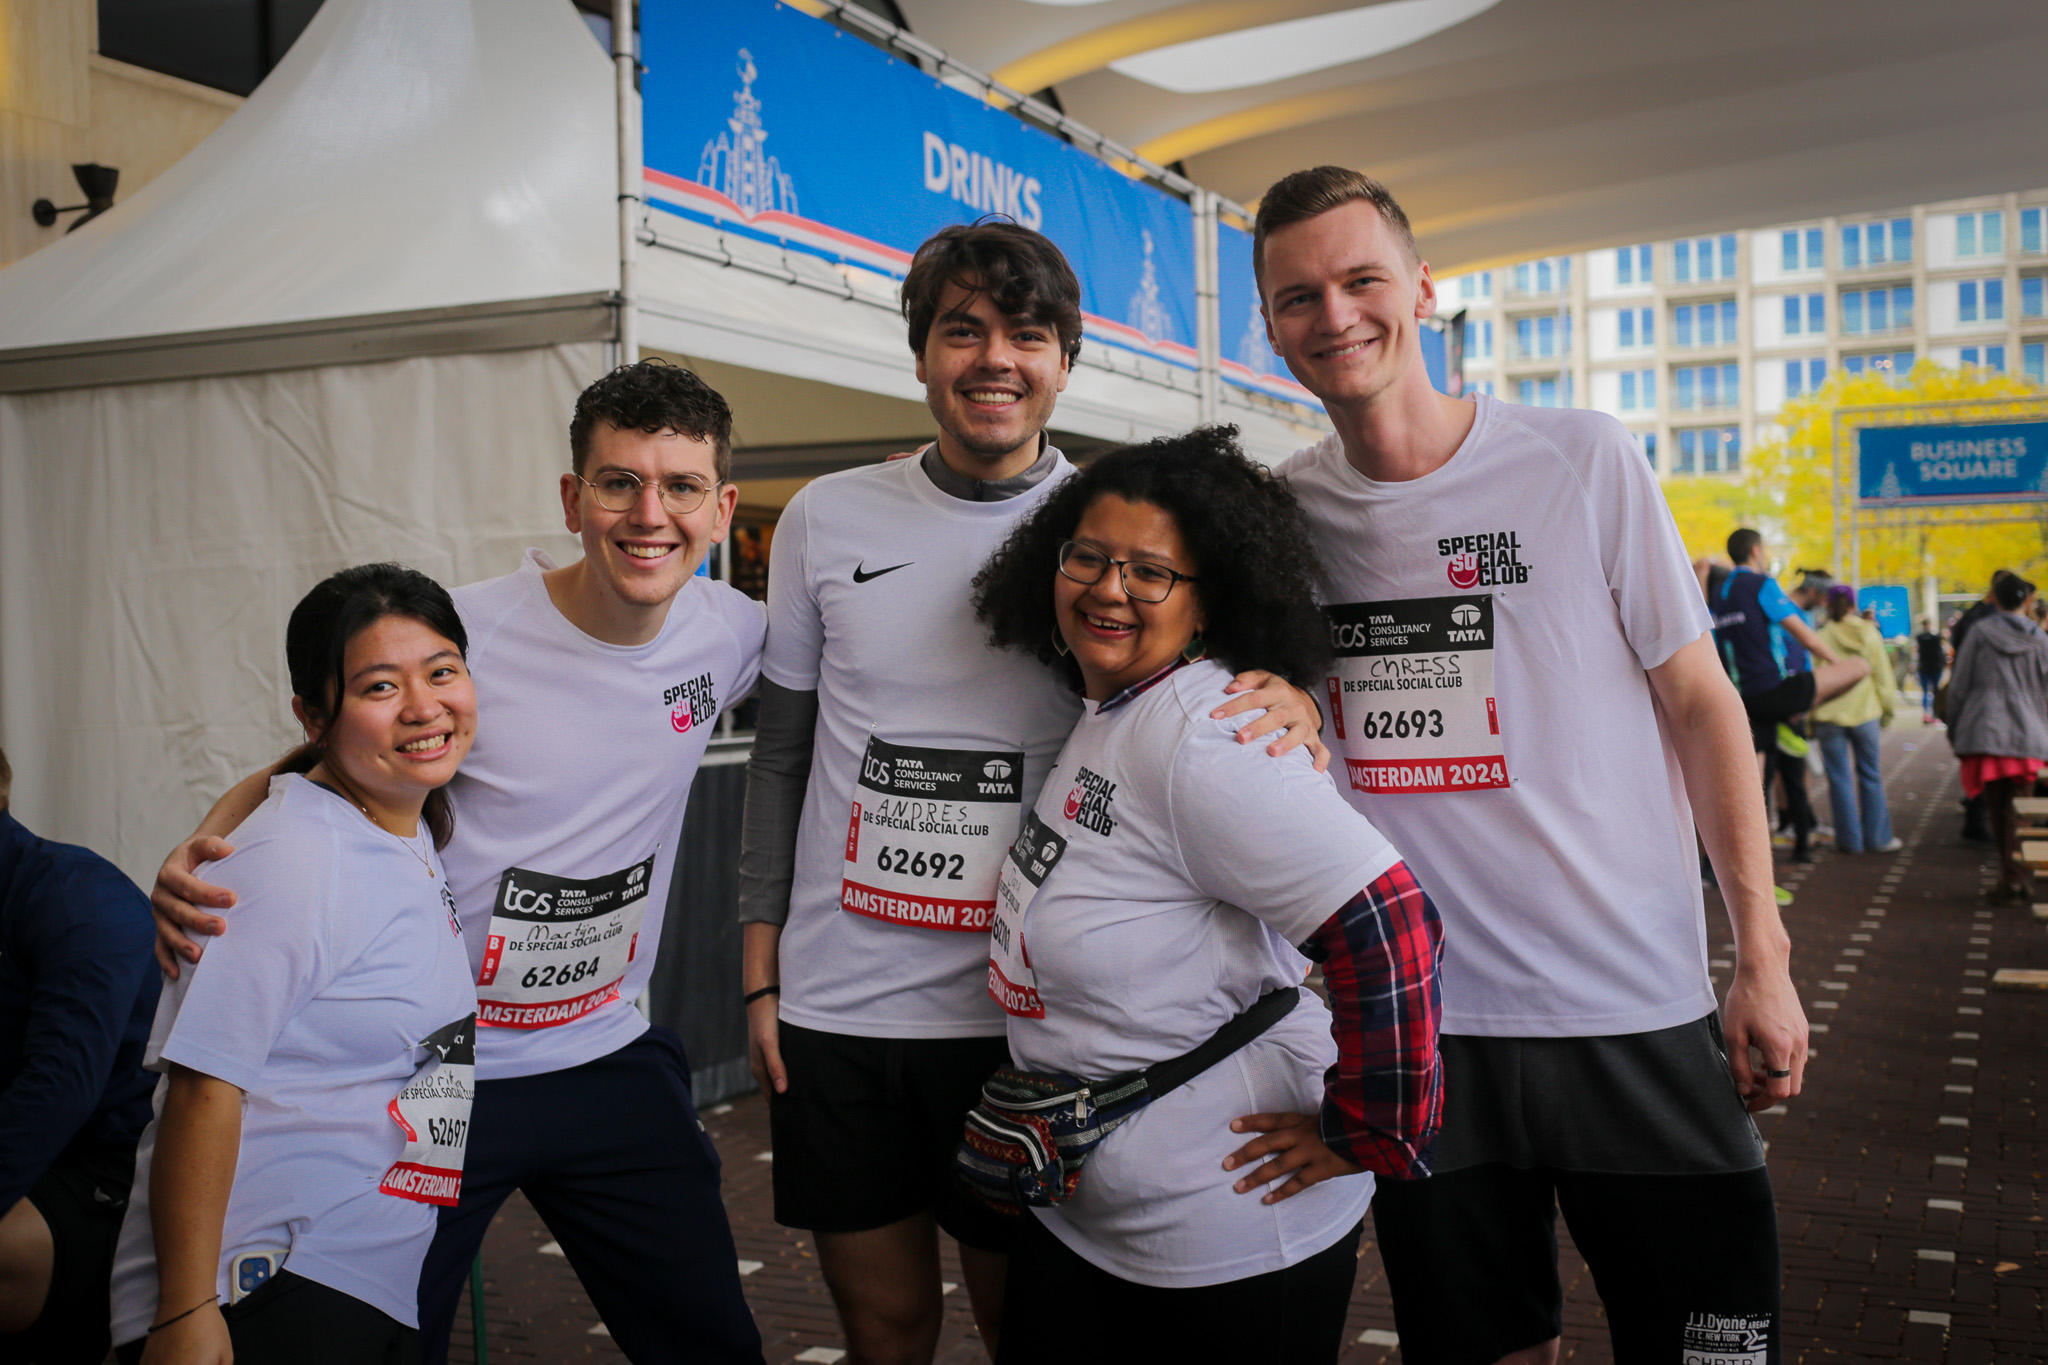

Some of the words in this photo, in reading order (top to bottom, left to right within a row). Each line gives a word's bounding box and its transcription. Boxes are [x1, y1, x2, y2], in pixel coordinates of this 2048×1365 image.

[923, 130, 1042, 232] DRINKS
[1910, 437, 2027, 461] BUSINESS
[1920, 458, 2018, 481] SQUARE
[1438, 531, 1521, 556] SPECIAL
[1479, 566, 1528, 586] CLUB
[1369, 615, 1395, 624] TATA
[1369, 623, 1431, 636] CONSULTANCY
[1370, 636, 1409, 647] SERVICES
[1447, 629, 1486, 642] TATA
[663, 672, 714, 706] SPECIAL
[1329, 680, 1336, 693] B
[1344, 680, 1356, 692] DE
[1357, 678, 1395, 691] SPECIAL
[1397, 677, 1433, 690] SOCIAL
[1435, 676, 1463, 689] CLUB
[692, 700, 716, 727] CLUB
[1363, 709, 1444, 739] 62693
[864, 748, 890, 785] tcs
[895, 758, 924, 769] TATA
[1349, 765, 1445, 787] AMSTERDAM
[1449, 763, 1505, 785] 2024
[894, 769, 962, 782] CONSULTANCY
[894, 779, 937, 791] SERVICES
[1075, 766, 1117, 802] SPECIAL
[977, 782, 1014, 794] TATA
[852, 804, 860, 817] B
[877, 798, 967, 825] ANDRES
[1076, 806, 1113, 837] CLUB
[863, 810, 874, 823] DE
[875, 814, 916, 832] SPECIAL
[918, 821, 958, 835] SOCIAL
[962, 824, 989, 836] CLUB
[877, 845, 965, 881] 62692
[504, 880, 553, 915] tcs
[557, 891, 614, 907] CONSULTANCY
[560, 889, 587, 898] TATA
[621, 883, 644, 900] TATA
[555, 906, 593, 916] SERVICES
[843, 886, 955, 926] AMSTERDAM
[961, 907, 996, 927] 202
[489, 937, 500, 950] B
[509, 941, 523, 951] DE
[526, 937, 568, 951] SPECIAL
[571, 934, 601, 949] SOCIAL
[603, 925, 623, 940] CLUB
[521, 956, 600, 988] 62684
[1005, 988, 1040, 1011] 2024
[400, 1088, 410, 1100] DE
[411, 1087, 442, 1099] SPECIAL
[441, 1087, 464, 1099] SOCIAL
[428, 1117, 467, 1148] 62697
[382, 1168, 455, 1199] AMSTERDAM
[1722, 1333, 1740, 1342] YORK
